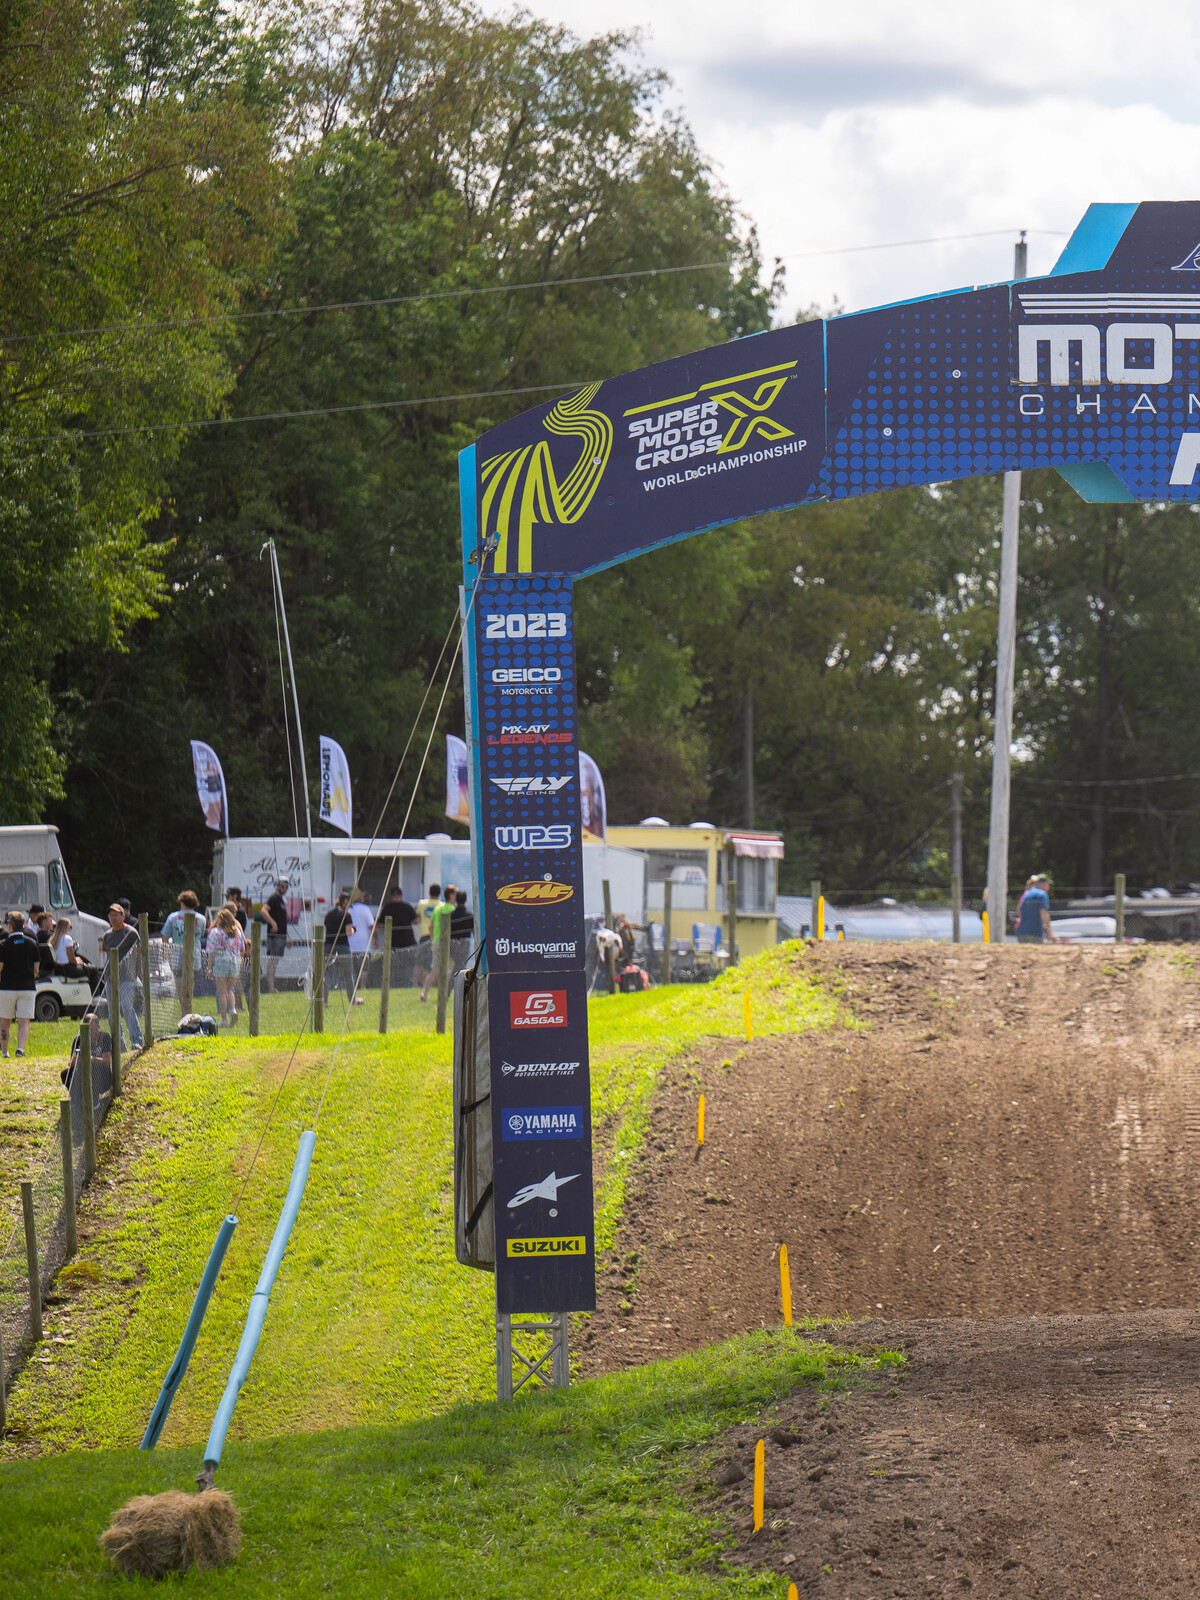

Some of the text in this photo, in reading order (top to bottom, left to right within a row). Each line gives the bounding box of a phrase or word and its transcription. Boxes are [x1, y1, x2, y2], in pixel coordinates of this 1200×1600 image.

[628, 401, 719, 438] SUPER
[638, 418, 717, 453] MOTO
[635, 434, 722, 471] CROSS
[643, 440, 807, 492] WORLD CHAMPIONSHIP
[486, 613, 567, 638] 2023
[492, 668, 561, 682] GEICO
[502, 687, 553, 695] MOTORCYCLE
[501, 724, 550, 734] MX-ATV
[488, 733, 572, 745] LEGENDS
[490, 776, 573, 791] FLY
[496, 826, 571, 849] WPS
[497, 884, 573, 900] FMF
[511, 941, 575, 954] Husqvarna
[514, 1016, 564, 1025] GASGAS
[516, 1062, 580, 1072] DUNLOP
[524, 1114, 577, 1129] YAMAHA
[512, 1240, 579, 1253] SUZUKI
